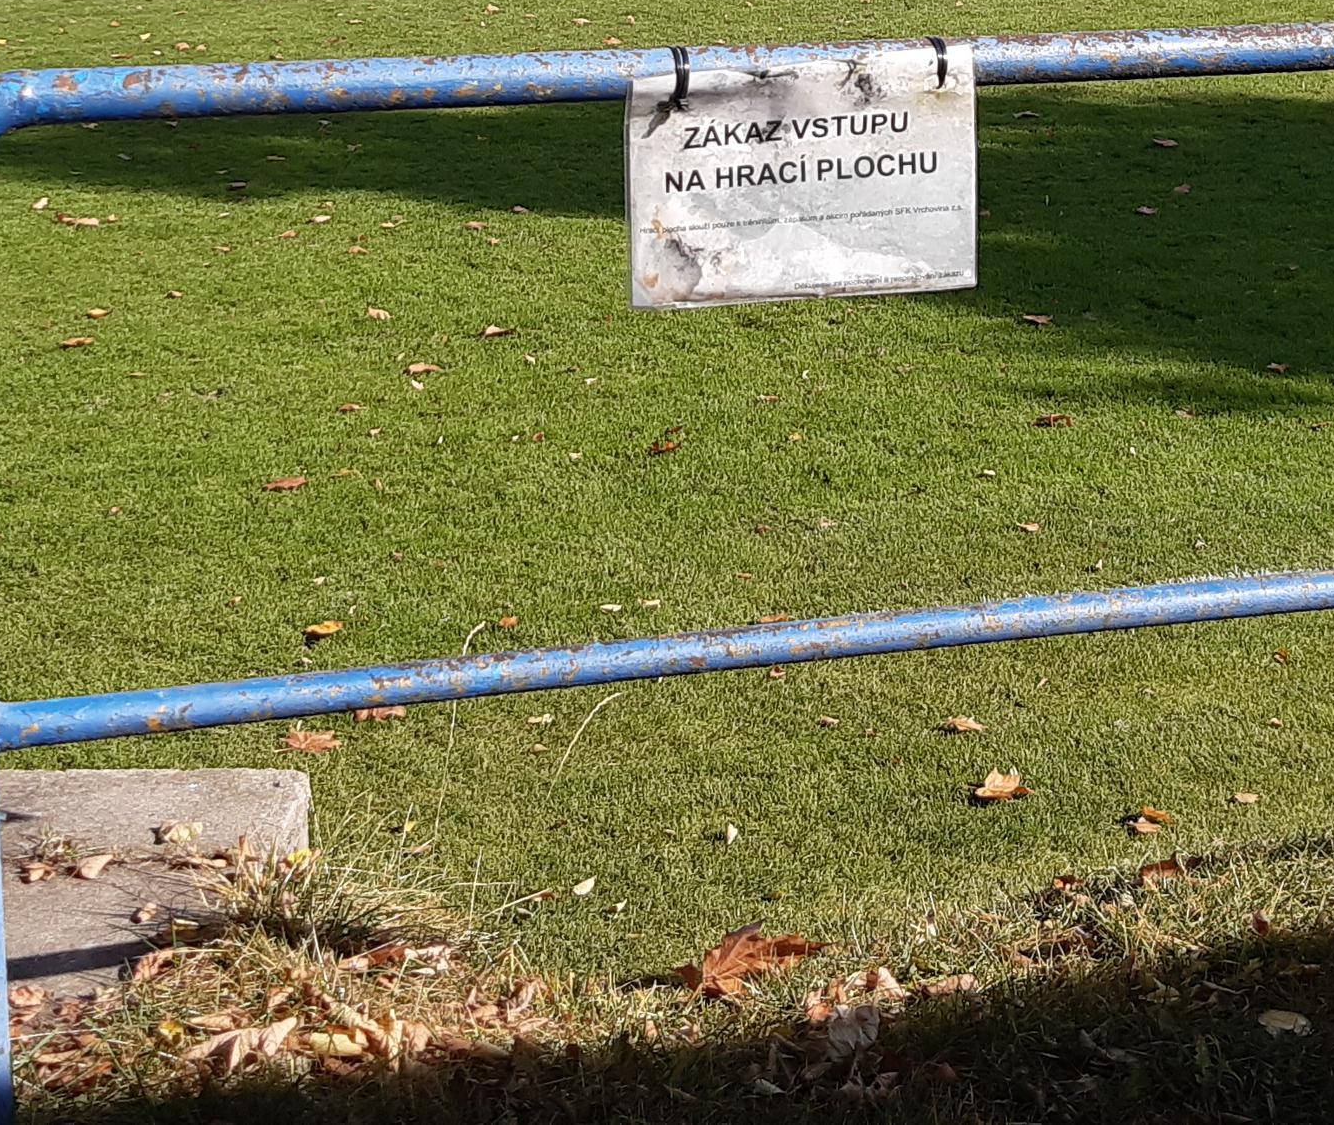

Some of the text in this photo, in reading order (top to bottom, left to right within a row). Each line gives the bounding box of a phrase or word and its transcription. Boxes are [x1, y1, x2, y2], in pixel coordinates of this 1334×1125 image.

[683, 111, 909, 150] ZÁKAZ VSTUPU
[665, 151, 938, 194] NA HRACÍ PLOCHU
[712, 221, 735, 231] pouze
[894, 207, 912, 216] SFK
[912, 205, 949, 215] Vrchovina
[844, 276, 883, 287] pochopení
